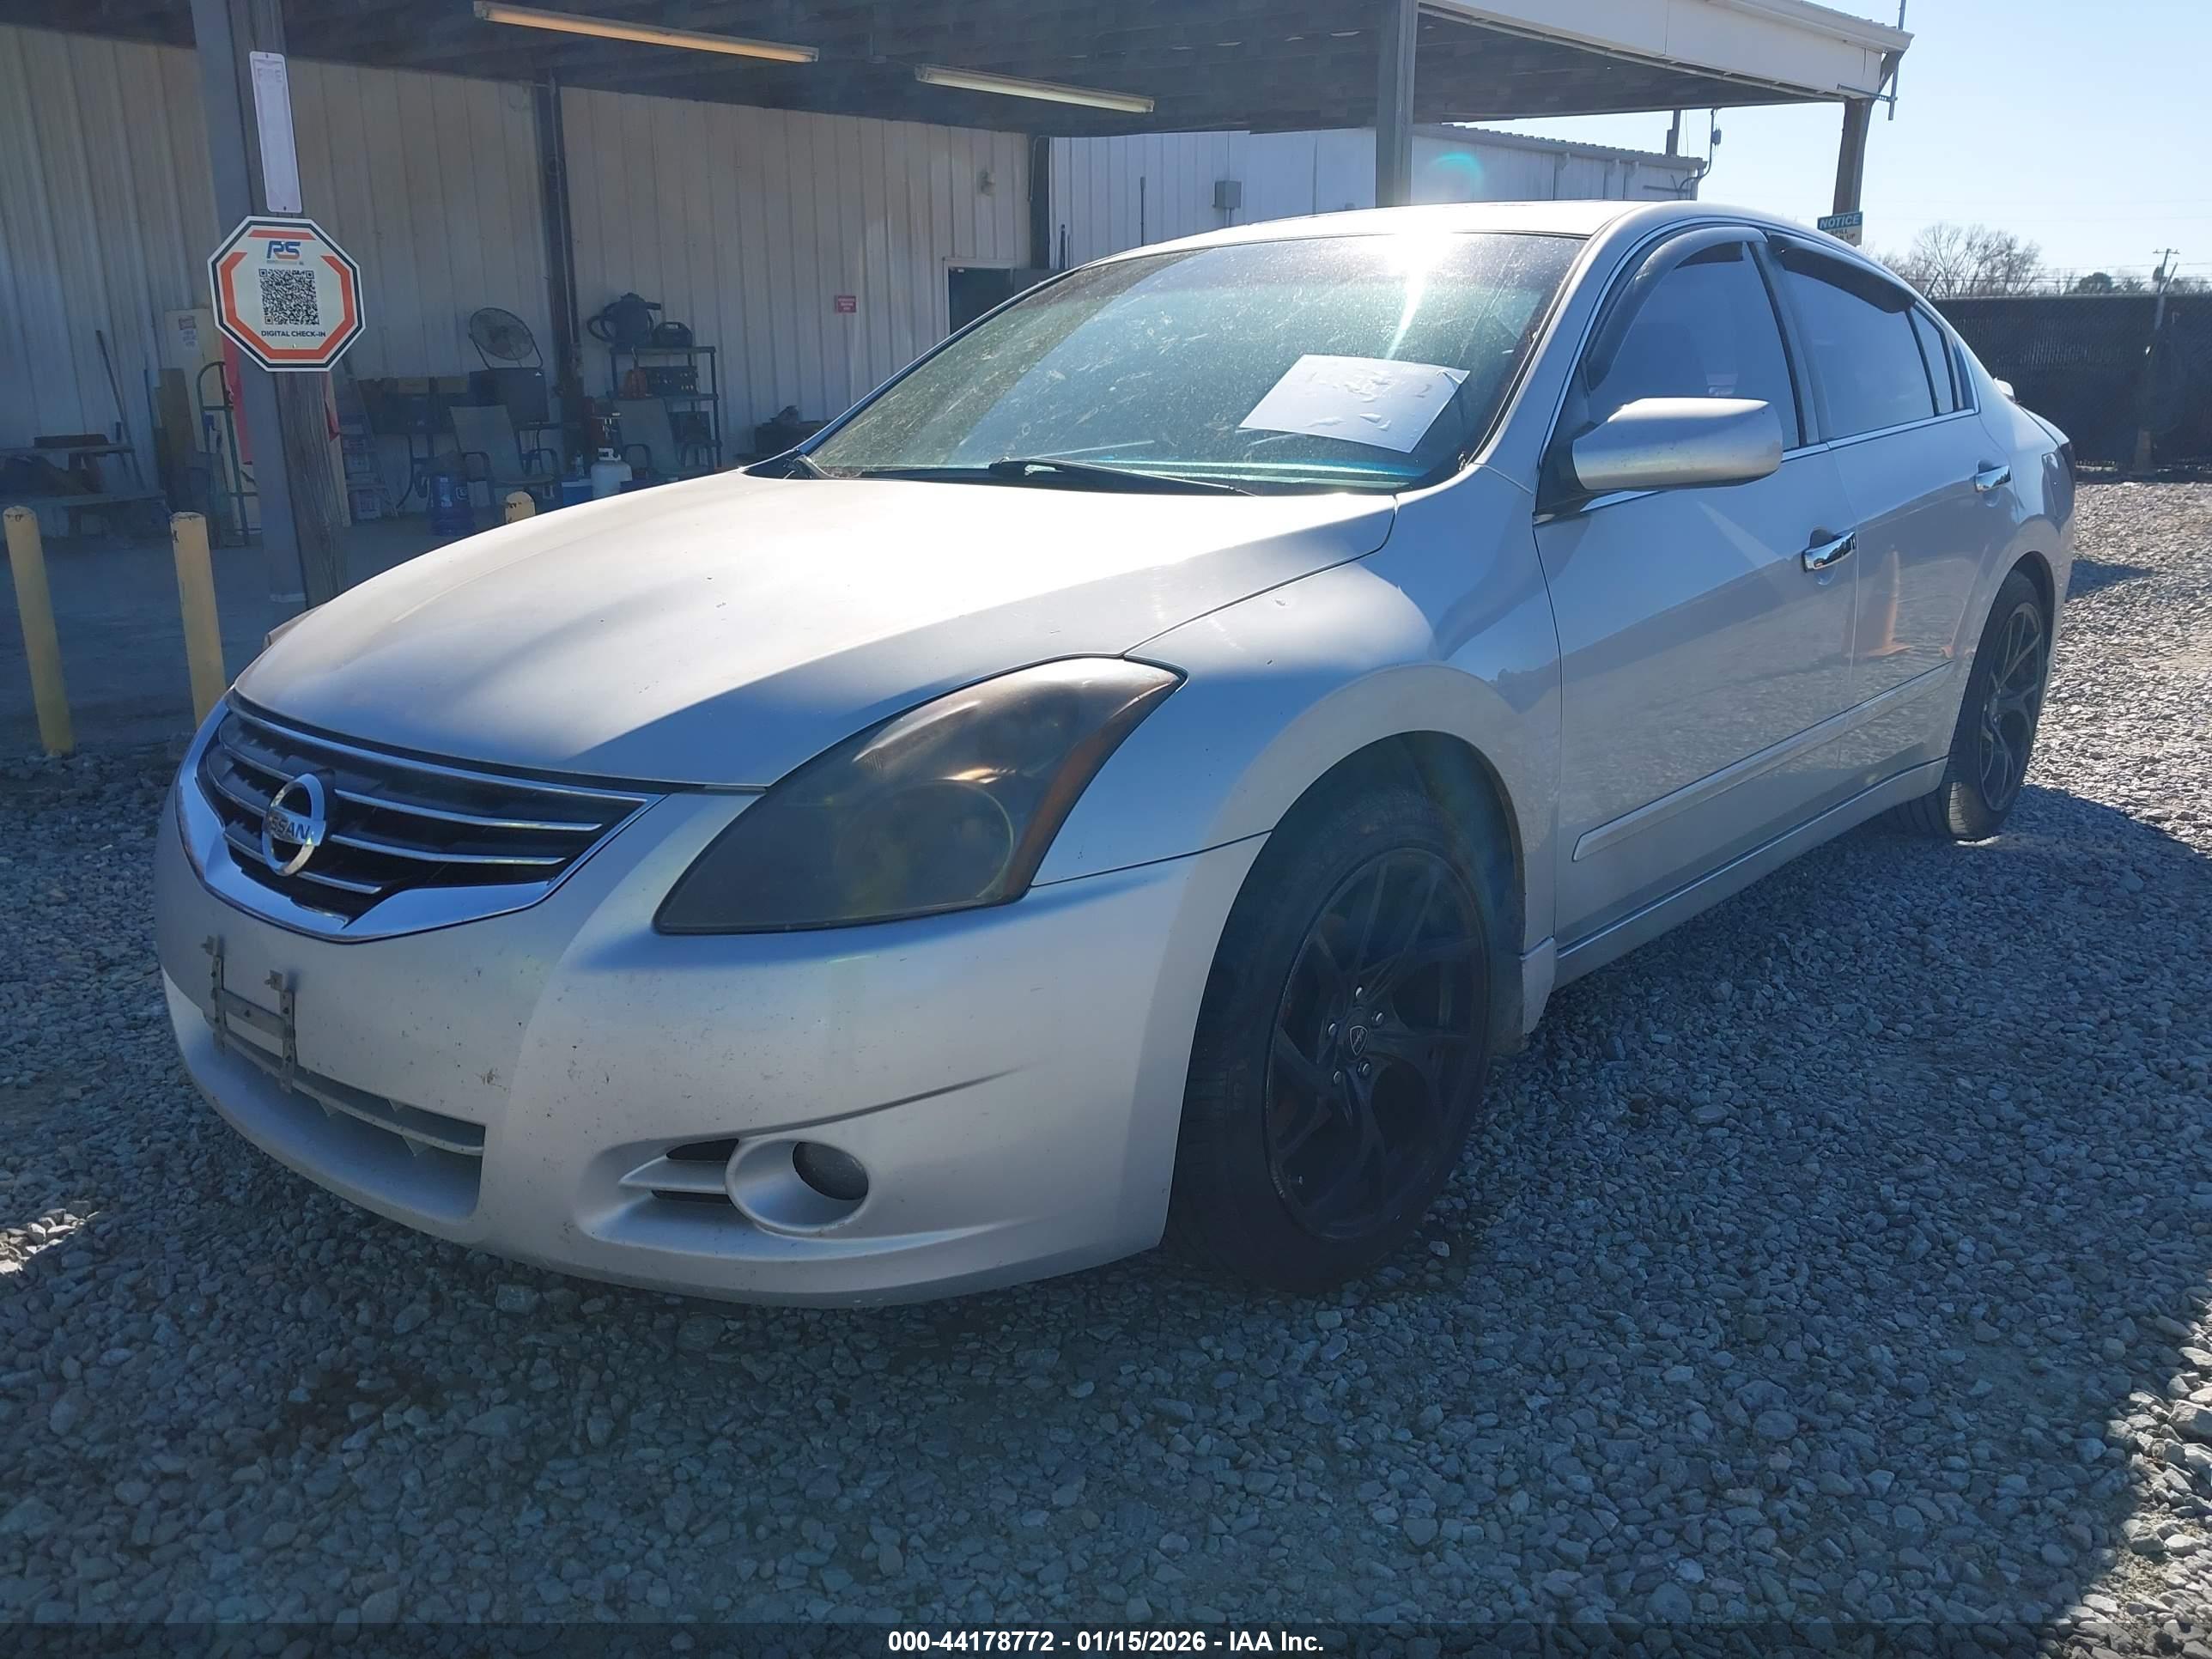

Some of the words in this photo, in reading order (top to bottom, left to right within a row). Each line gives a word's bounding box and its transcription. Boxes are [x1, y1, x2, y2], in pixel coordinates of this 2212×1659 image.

[1819, 214, 1860, 229] NOTICE
[266, 240, 301, 260] RS
[265, 811, 311, 840] SSAN
